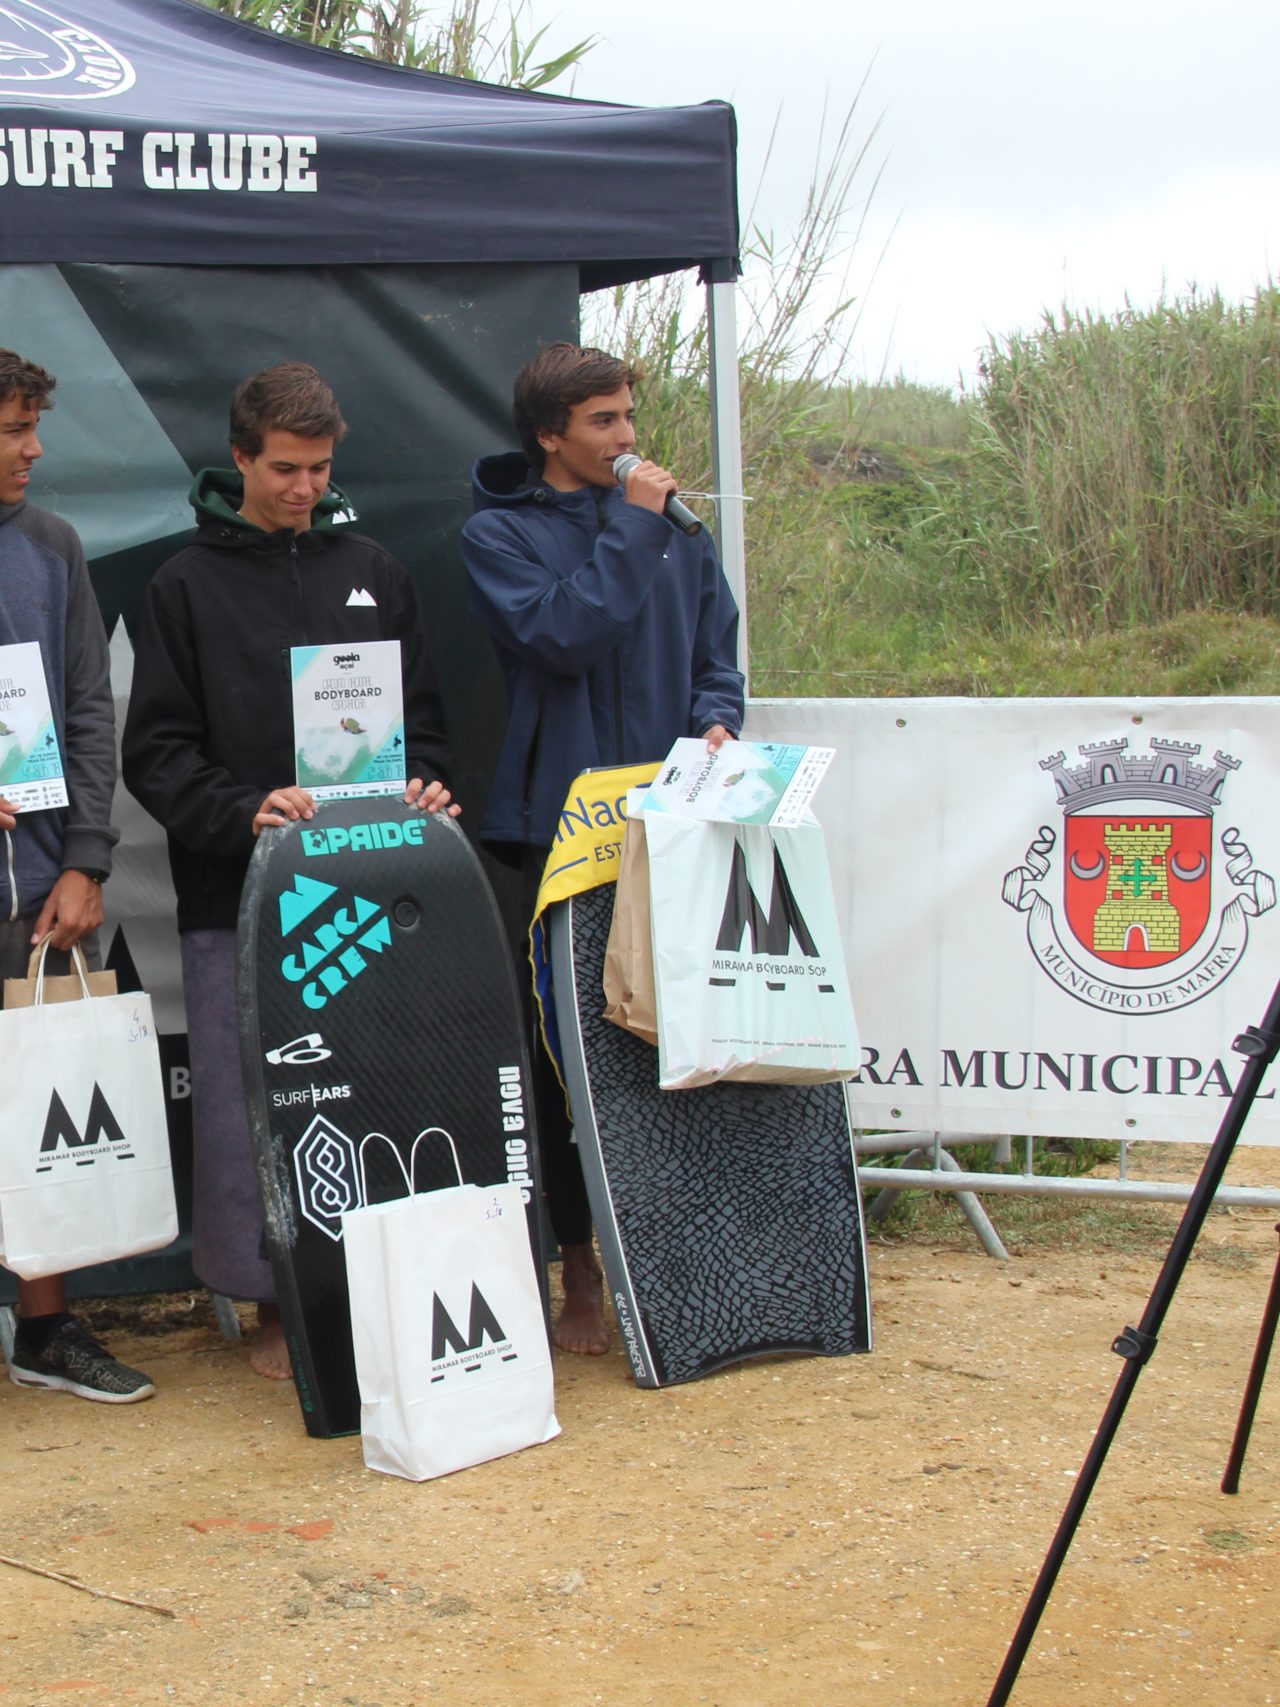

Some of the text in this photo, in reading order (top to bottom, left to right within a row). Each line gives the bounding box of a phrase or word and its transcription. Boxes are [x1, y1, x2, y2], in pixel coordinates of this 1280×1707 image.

[141, 132, 318, 192] CLUBE
[314, 687, 382, 701] BODYBOARD
[686, 753, 719, 803] BODYBOARD
[302, 916, 392, 1010] CREW
[1040, 944, 1237, 1009] MUNICÍPIO DE MAFRA
[498, 1066, 524, 1132] nova
[39, 1143, 132, 1163] MIRAMAR BODYBOARD SHOP
[431, 1343, 513, 1372] MIRAMAR BODYBOARD SHOP
